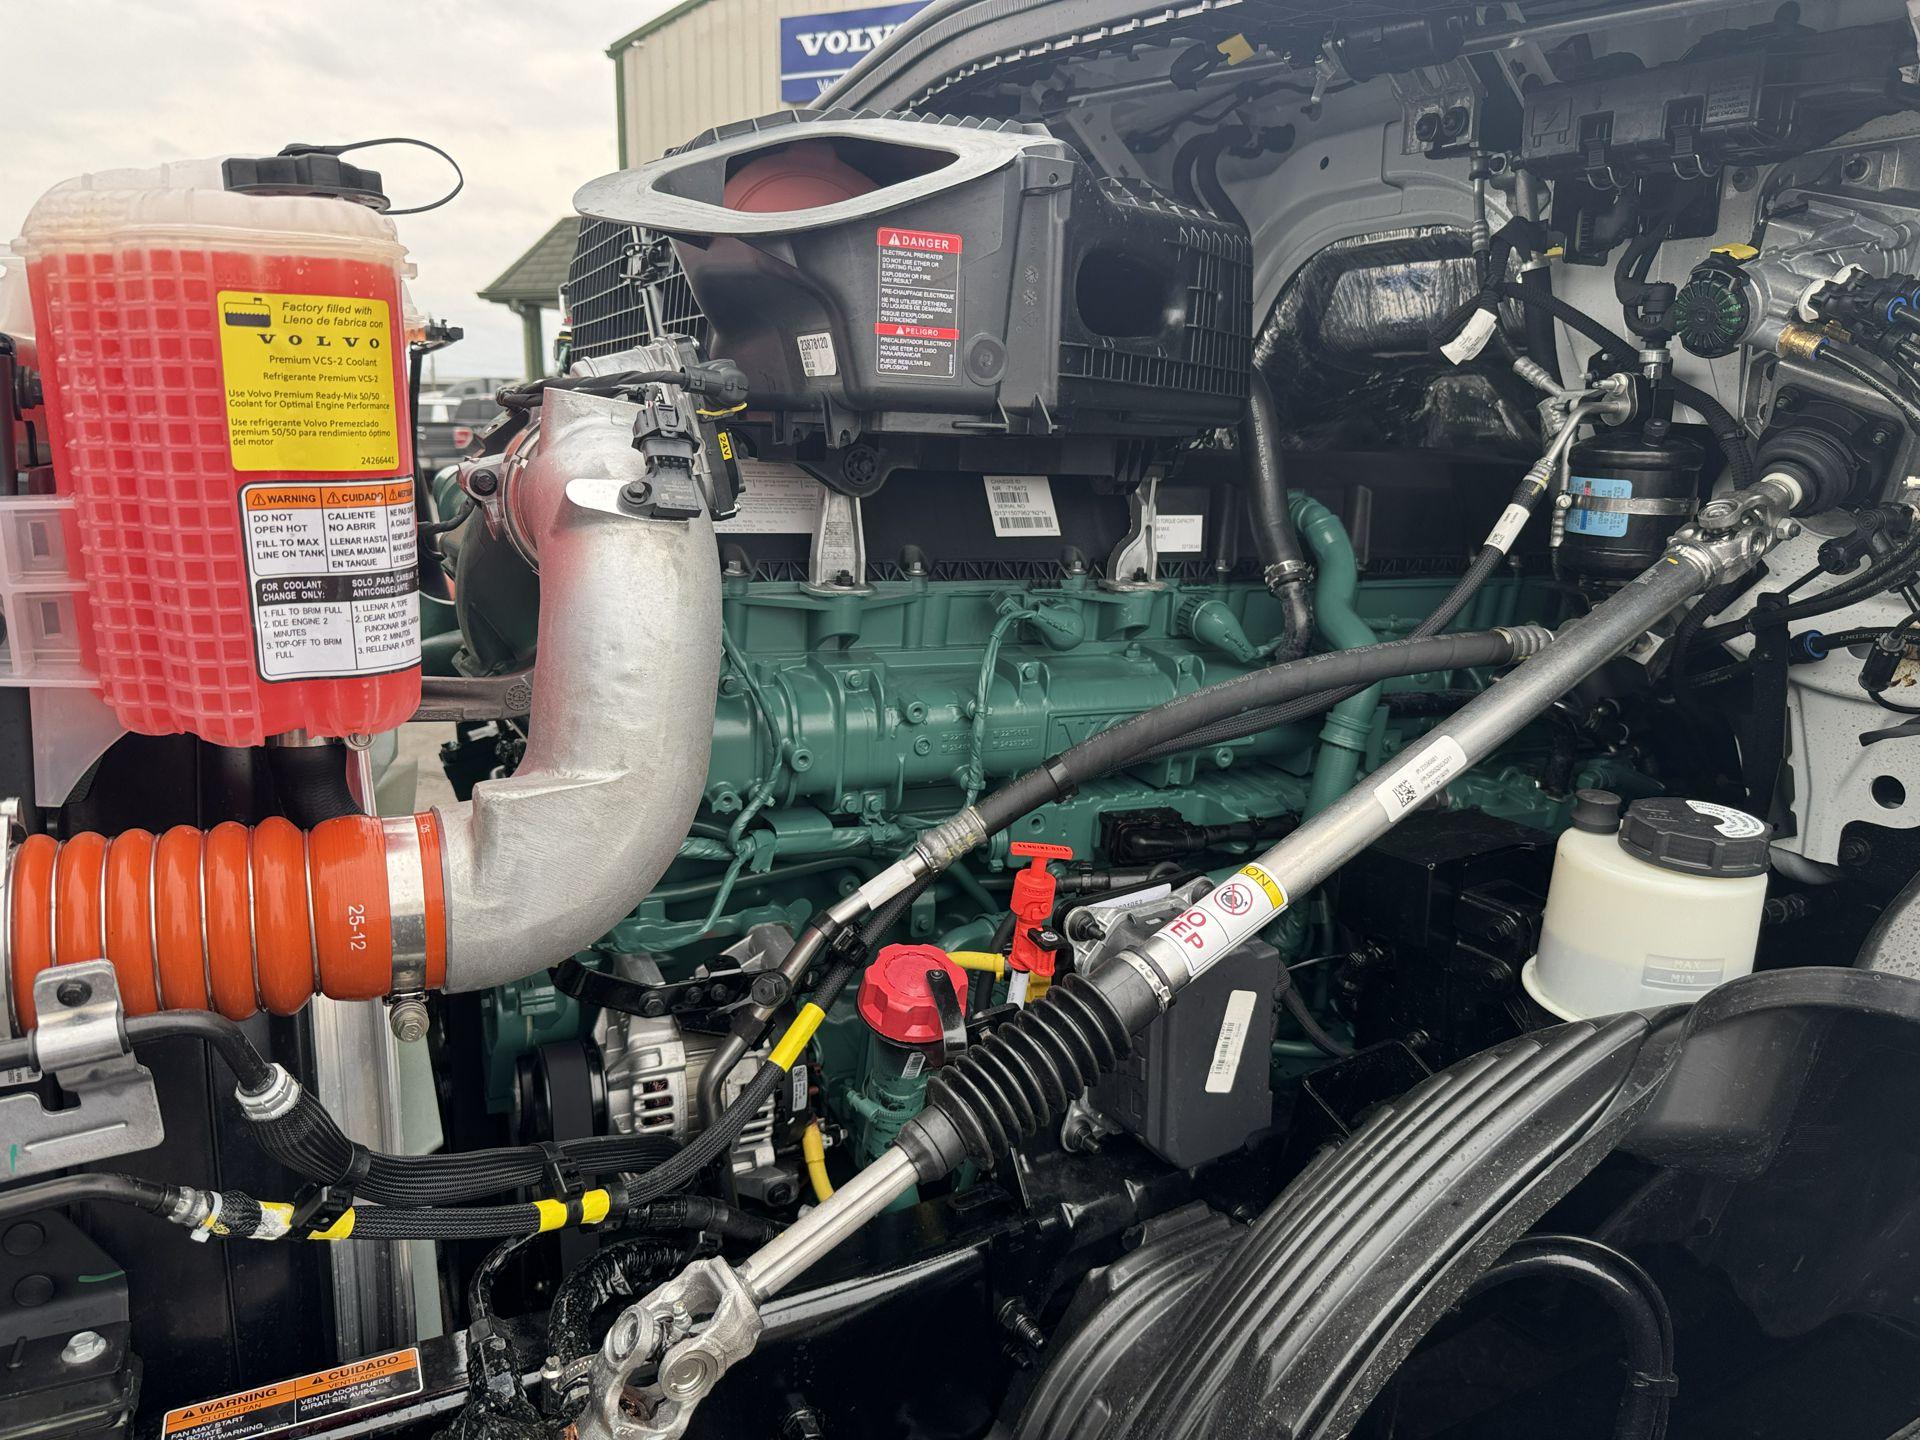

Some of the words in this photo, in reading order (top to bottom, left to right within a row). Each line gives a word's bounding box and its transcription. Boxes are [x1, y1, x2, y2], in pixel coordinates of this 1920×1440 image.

[796, 23, 904, 56] VOLV
[903, 236, 949, 249] DANGER
[883, 249, 912, 257] ELECTRICAL
[914, 252, 943, 260] PREHEATER
[881, 288, 922, 297] PRE-CHAUFFAGE
[283, 302, 323, 314] Factory
[327, 303, 351, 314] filled
[355, 306, 372, 315] with
[283, 315, 313, 325] Lleno
[317, 316, 330, 324] de
[334, 317, 366, 328] fabrica
[906, 328, 938, 336] PELIGRO
[258, 334, 379, 349] VOLVO
[881, 337, 923, 345] PRECALENTADOR
[270, 355, 310, 364] Premium
[313, 356, 342, 365] VCS-2
[346, 357, 377, 367] Coolant
[264, 372, 316, 382] Refrigerante
[319, 374, 356, 382] Premium
[229, 390, 245, 398] Use
[248, 390, 271, 398] Volvo
[275, 391, 313, 399] Premium
[316, 392, 358, 401] Ready-Mix
[360, 392, 379, 400] 50/50
[230, 400, 262, 408] Coolant
[265, 400, 277, 408] for
[280, 401, 313, 410] Optimal
[316, 402, 344, 411] Engine
[250, 418, 301, 428] refrigerante
[330, 420, 378, 428] Premezclado
[233, 429, 269, 437] premium
[299, 430, 316, 438] para
[369, 430, 390, 438] óptimo
[233, 438, 245, 446] del
[720, 437, 730, 455] 24V
[268, 495, 315, 503] WARNING
[342, 493, 384, 502] CUIDADO
[254, 514, 268, 522] DO
[328, 511, 376, 520] CALIENTE
[255, 525, 283, 534] OPEN
[287, 524, 308, 532] HOT
[347, 523, 376, 531] ABRIR
[256, 539, 277, 548] FILL
[281, 539, 294, 547] TO
[297, 538, 319, 546] MAX
[330, 537, 361, 546] LLENAR
[363, 536, 387, 544] HASTA
[257, 551, 279, 560] LINE
[282, 550, 296, 558] ON
[299, 549, 325, 557] TANK
[331, 548, 355, 556] LINEA
[357, 546, 386, 555] MAXIMA
[345, 559, 377, 567] TANQUE
[352, 578, 372, 587] SOLO
[376, 576, 394, 586] PARA
[397, 572, 414, 583] CAMBIAR
[262, 583, 278, 591] FOR
[283, 581, 322, 590] COOLANT
[263, 592, 296, 601] CHANGE
[302, 591, 325, 599] ONLY:
[303, 607, 321, 615] BRIM
[325, 606, 342, 614] FULL
[363, 602, 389, 611] LLENAR
[398, 599, 407, 608] TOPE
[355, 616, 362, 624] 2.
[364, 614, 386, 622] DEJAR
[388, 610, 406, 619] MOTOR
[272, 619, 288, 627] IDLE
[364, 621, 400, 633] FUNCIONAR
[274, 629, 306, 638] MINUTES
[366, 635, 380, 643] POR
[390, 629, 410, 640] MINUTOS
[266, 642, 273, 650] 3.
[276, 639, 306, 649] TOP-OFF
[366, 642, 399, 654] RELLENAR
[401, 641, 405, 649] A
[406, 638, 415, 647] TOPE
[276, 651, 294, 659] FULL
[1241, 868, 1270, 886] ON
[349, 904, 366, 950] 25-12
[1673, 961, 1700, 969] MAX
[1671, 974, 1695, 983] MIN
[328, 1356, 399, 1380] CUIDADO
[328, 1370, 385, 1389] VENTILADOR
[301, 1386, 358, 1405] VENTILADOR
[360, 1376, 391, 1390] PUEDE
[199, 1389, 278, 1414] WARNING
[301, 1398, 330, 1411] GIRAR
[332, 1395, 349, 1405] SIN
[350, 1387, 378, 1400] AVISO.
[201, 1407, 241, 1423] CLUTCH
[243, 1402, 262, 1412] FAN
[171, 1431, 189, 1440] FAN
[192, 1426, 214, 1434] MAY
[215, 1416, 244, 1427] START
[218, 1423, 265, 1439] WARNING.
[189, 1428, 222, 1440] ROTATE
